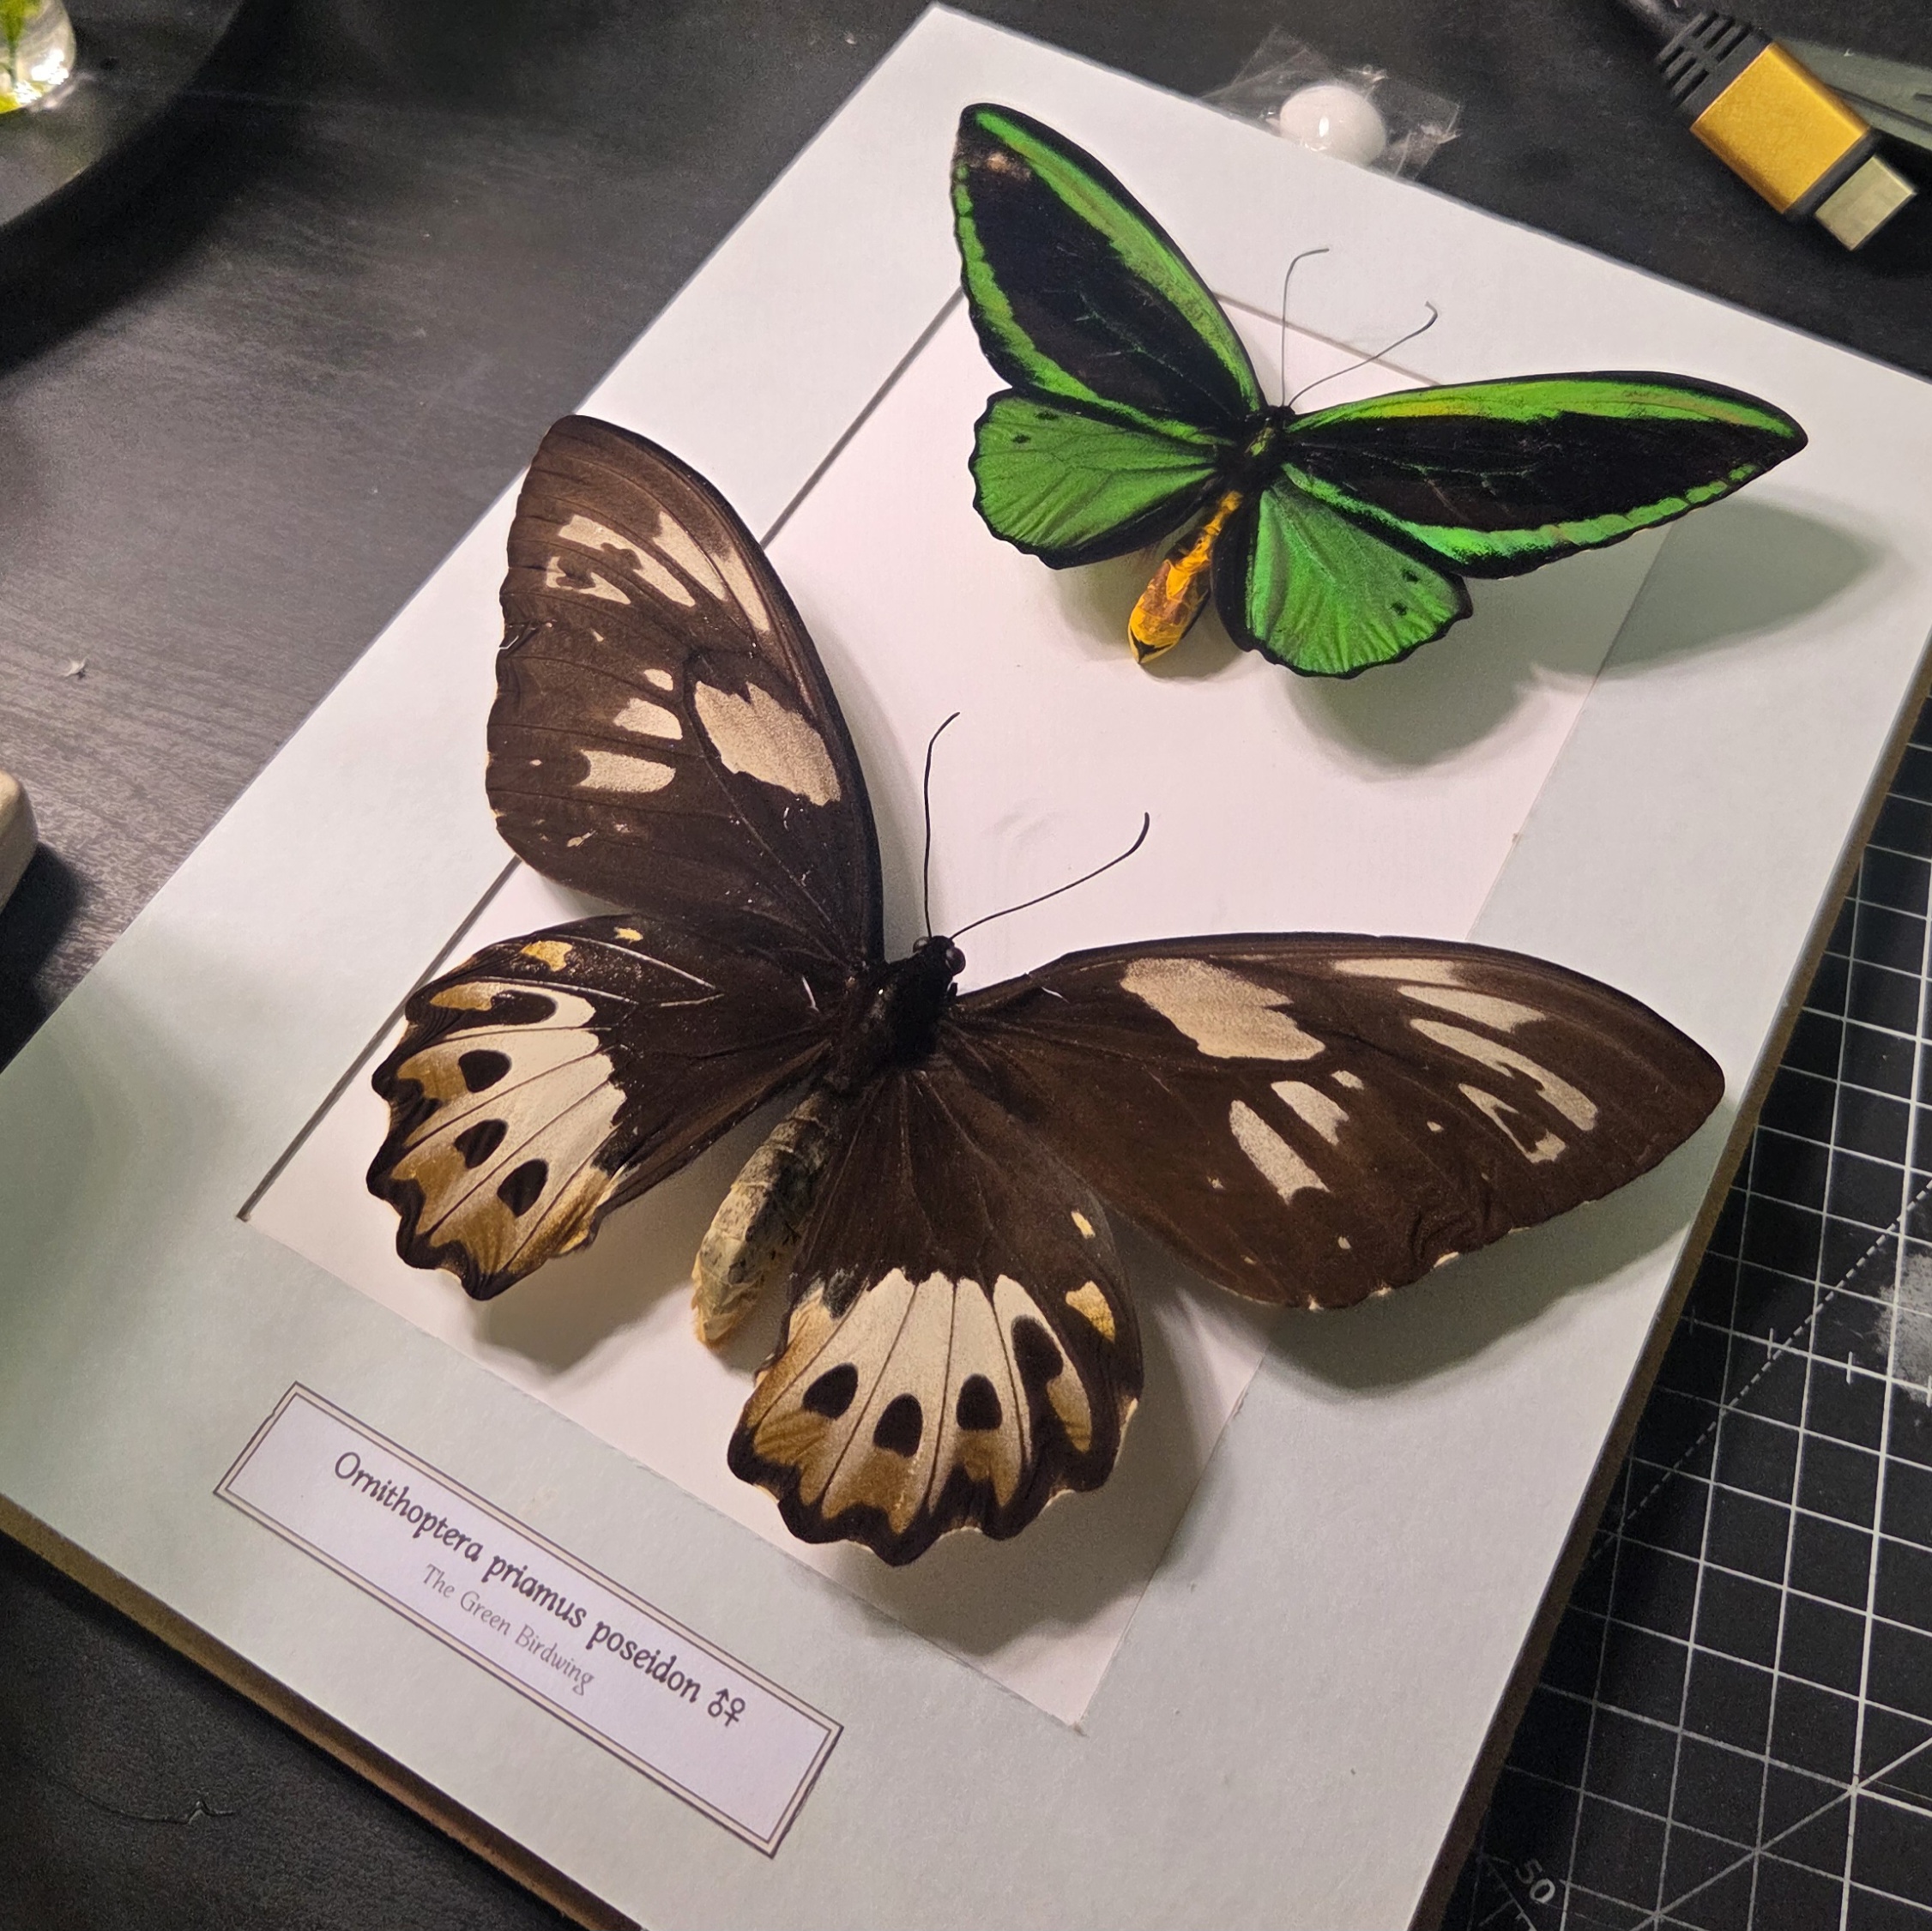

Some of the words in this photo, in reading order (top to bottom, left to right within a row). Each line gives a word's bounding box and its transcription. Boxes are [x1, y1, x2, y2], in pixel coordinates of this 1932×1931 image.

[334, 1451, 483, 1562] Ornithoptera
[480, 1554, 587, 1628] priamus
[585, 1620, 701, 1704] poseidon
[423, 1564, 456, 1599] The
[460, 1590, 512, 1636] Green
[515, 1624, 595, 1696] Birdwing
[1514, 1858, 1556, 1904] 50
